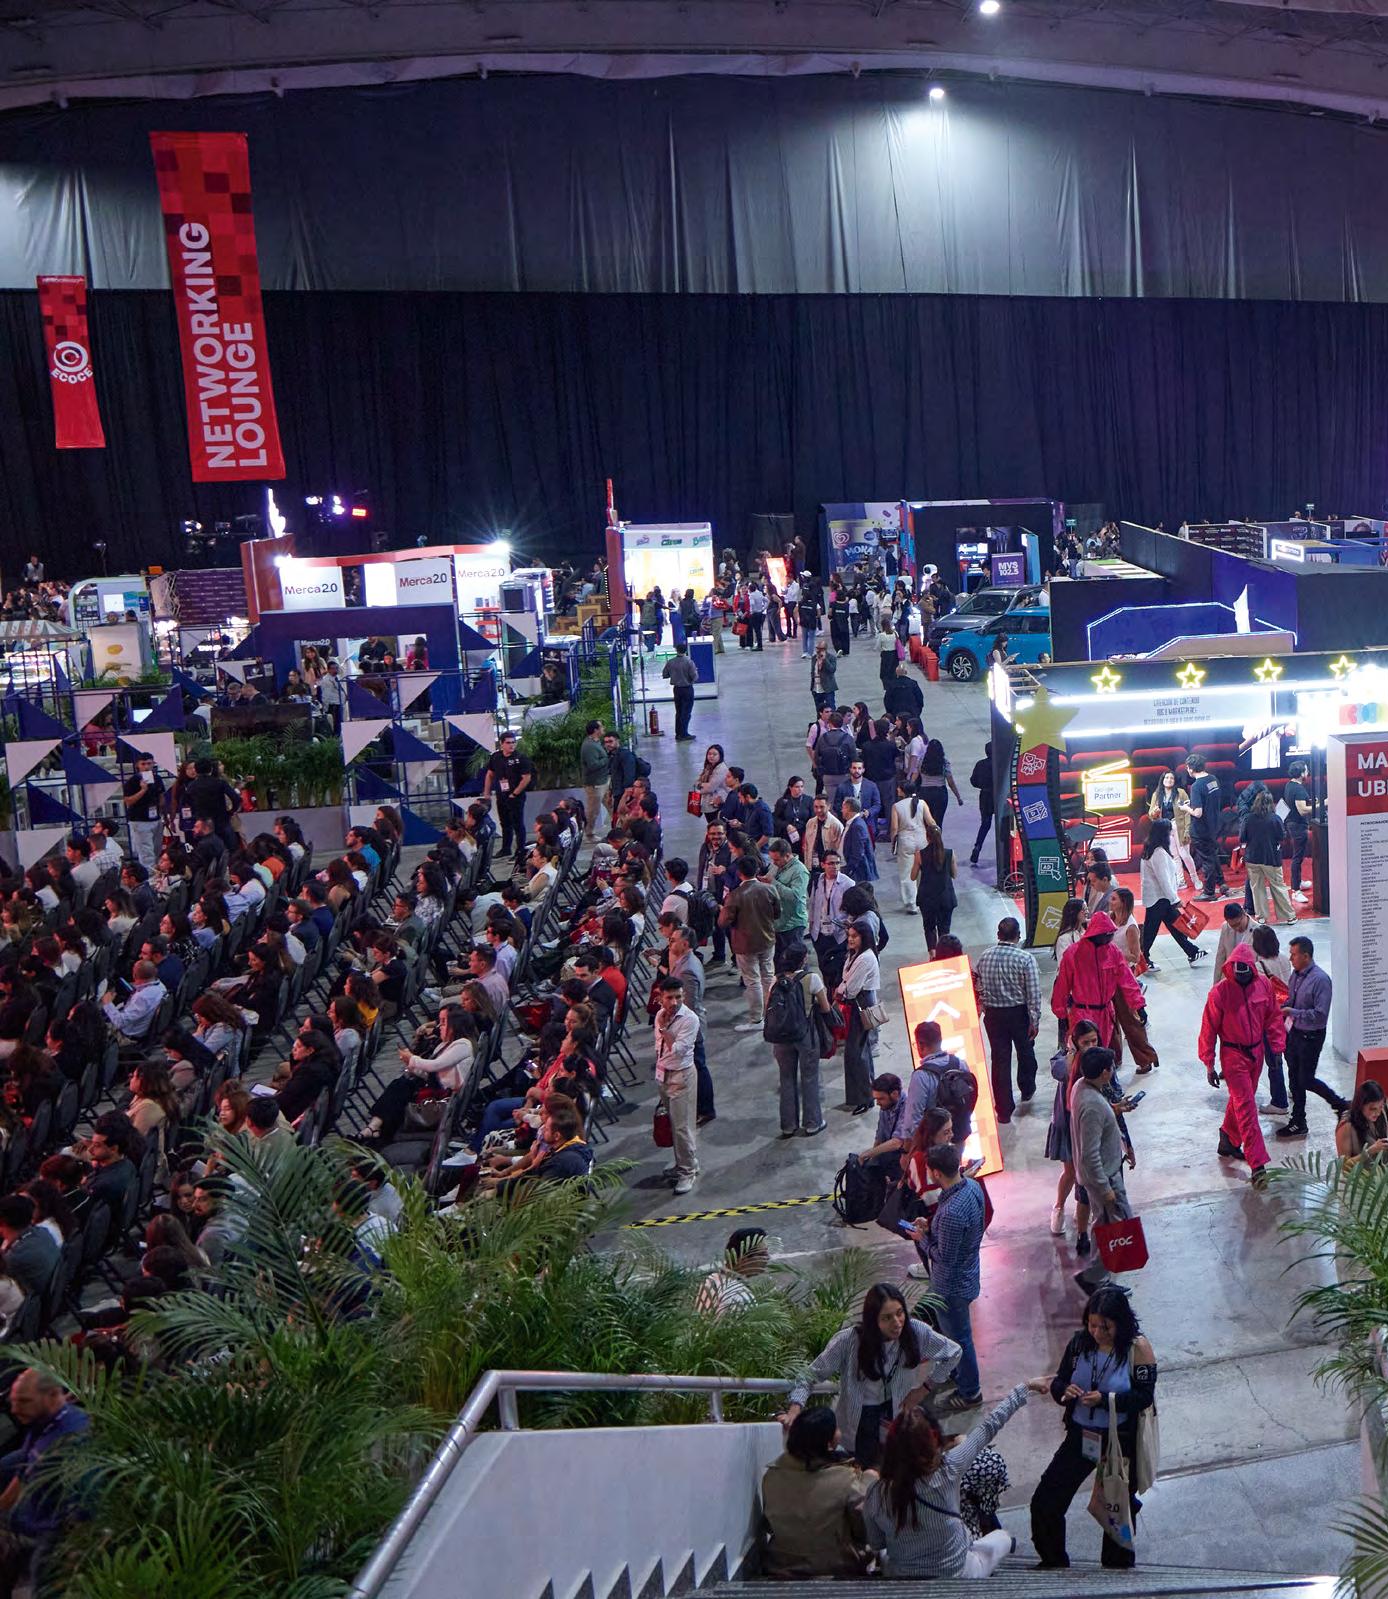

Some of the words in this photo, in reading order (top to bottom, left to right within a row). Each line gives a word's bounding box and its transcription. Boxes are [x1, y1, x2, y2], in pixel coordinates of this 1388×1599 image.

[179, 222, 237, 468] NETWORKING
[51, 366, 94, 384] ECOCE
[222, 322, 268, 467] LOUNGE
[998, 561, 1019, 570] MVS
[1094, 792, 1121, 800] Partner
